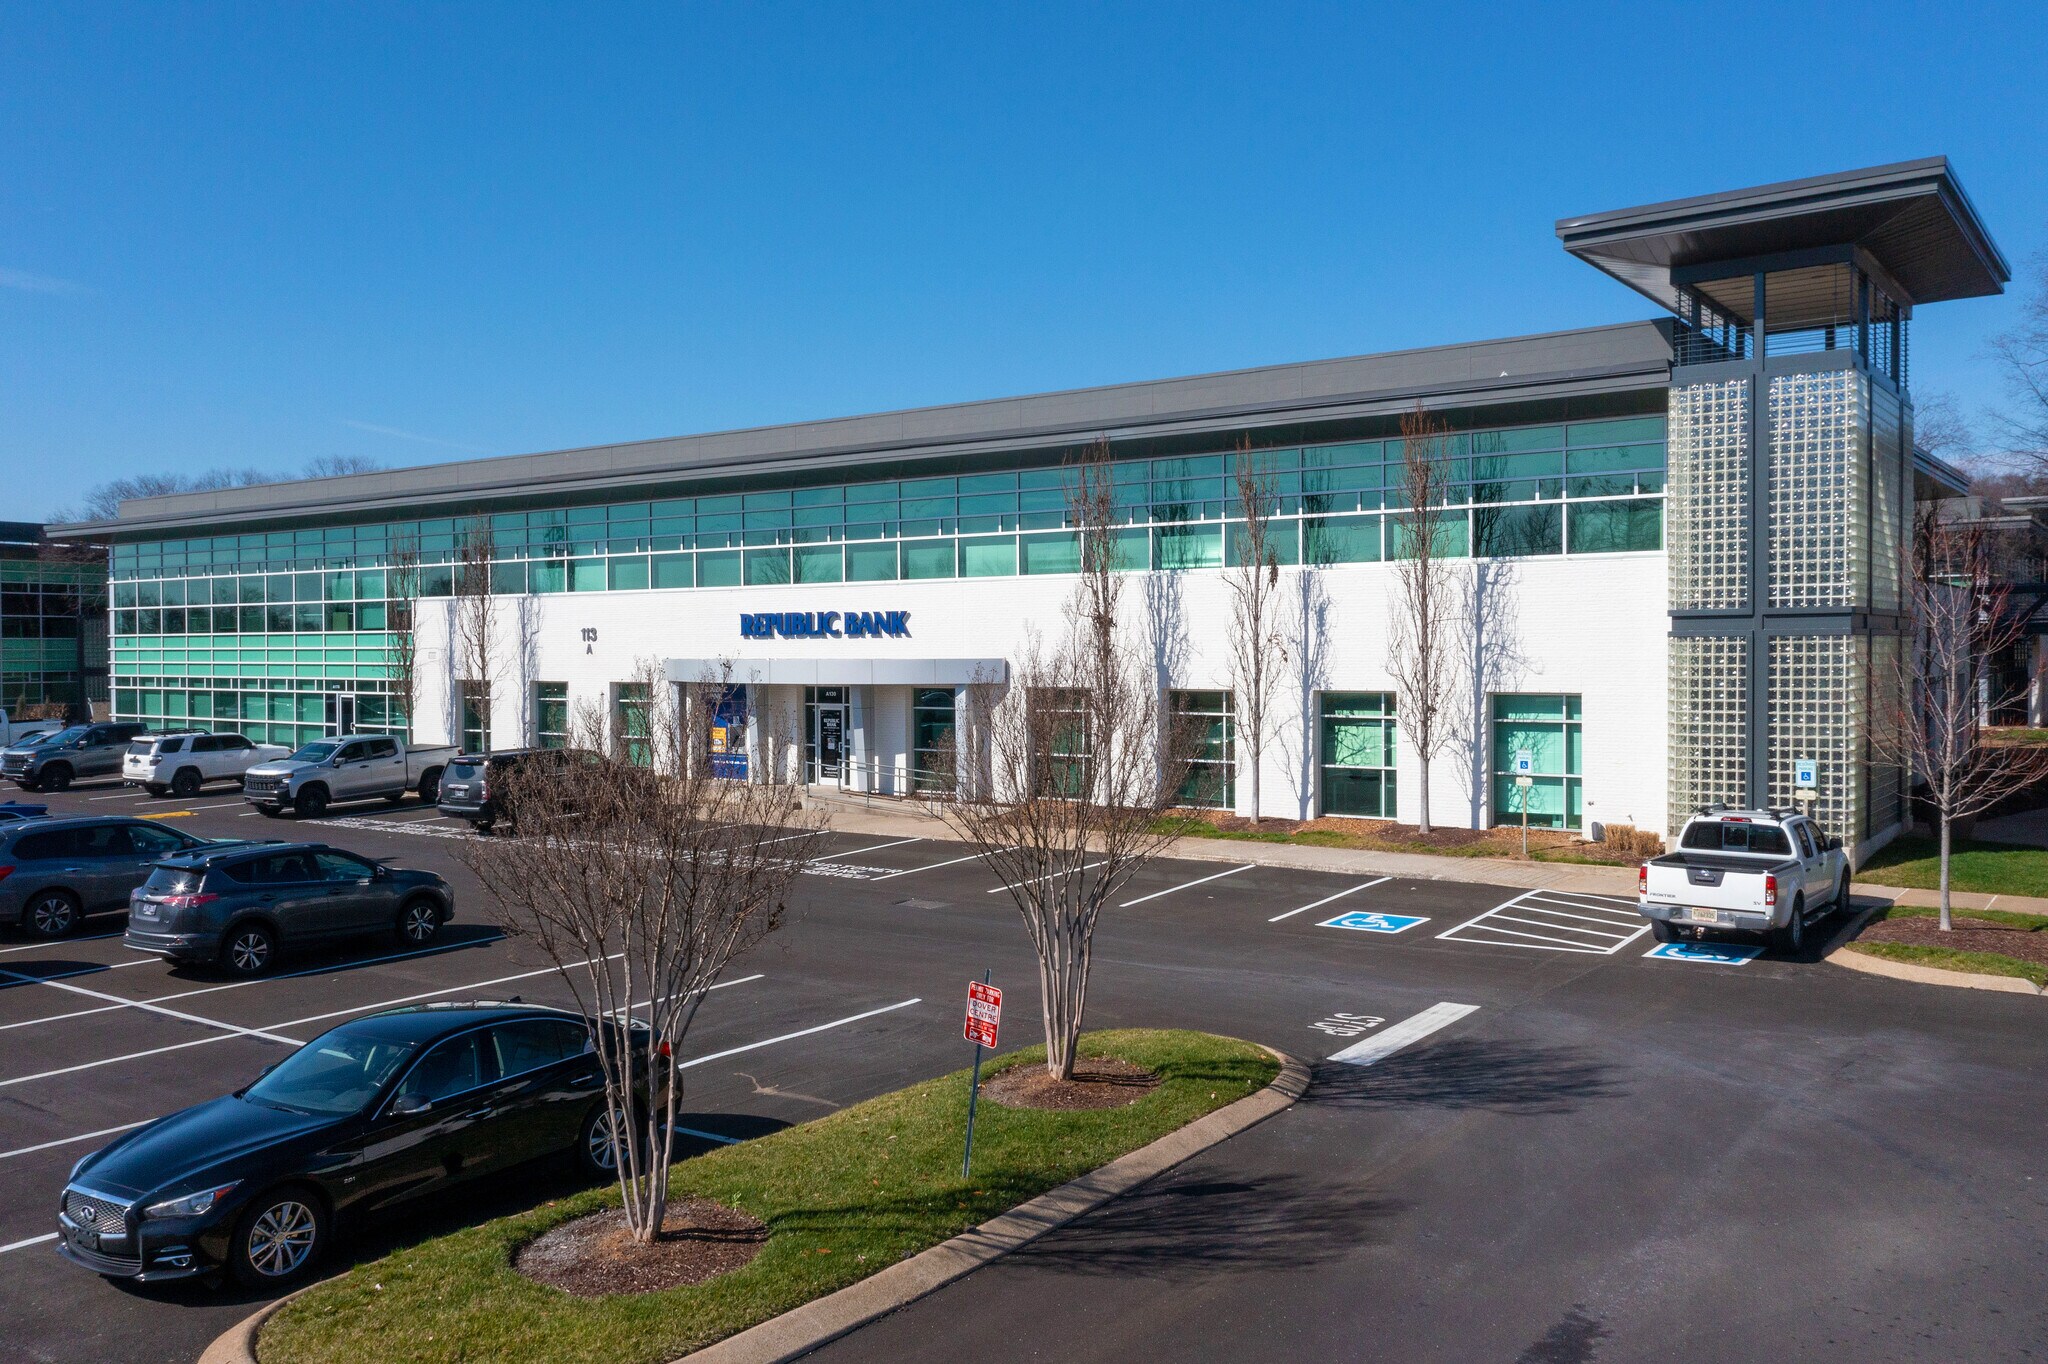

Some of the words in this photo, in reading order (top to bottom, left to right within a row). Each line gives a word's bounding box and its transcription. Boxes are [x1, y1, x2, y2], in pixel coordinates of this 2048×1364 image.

[740, 611, 842, 637] REPUBLIC
[844, 611, 908, 636] BANK
[580, 627, 598, 642] 113
[586, 643, 593, 655] A
[971, 983, 984, 993] PERMIT
[985, 988, 1001, 998] PARKING
[976, 992, 986, 1000] ONLY
[986, 995, 995, 1003] FOR
[972, 1001, 996, 1013] DOVER
[970, 1008, 997, 1022] CENTRE
